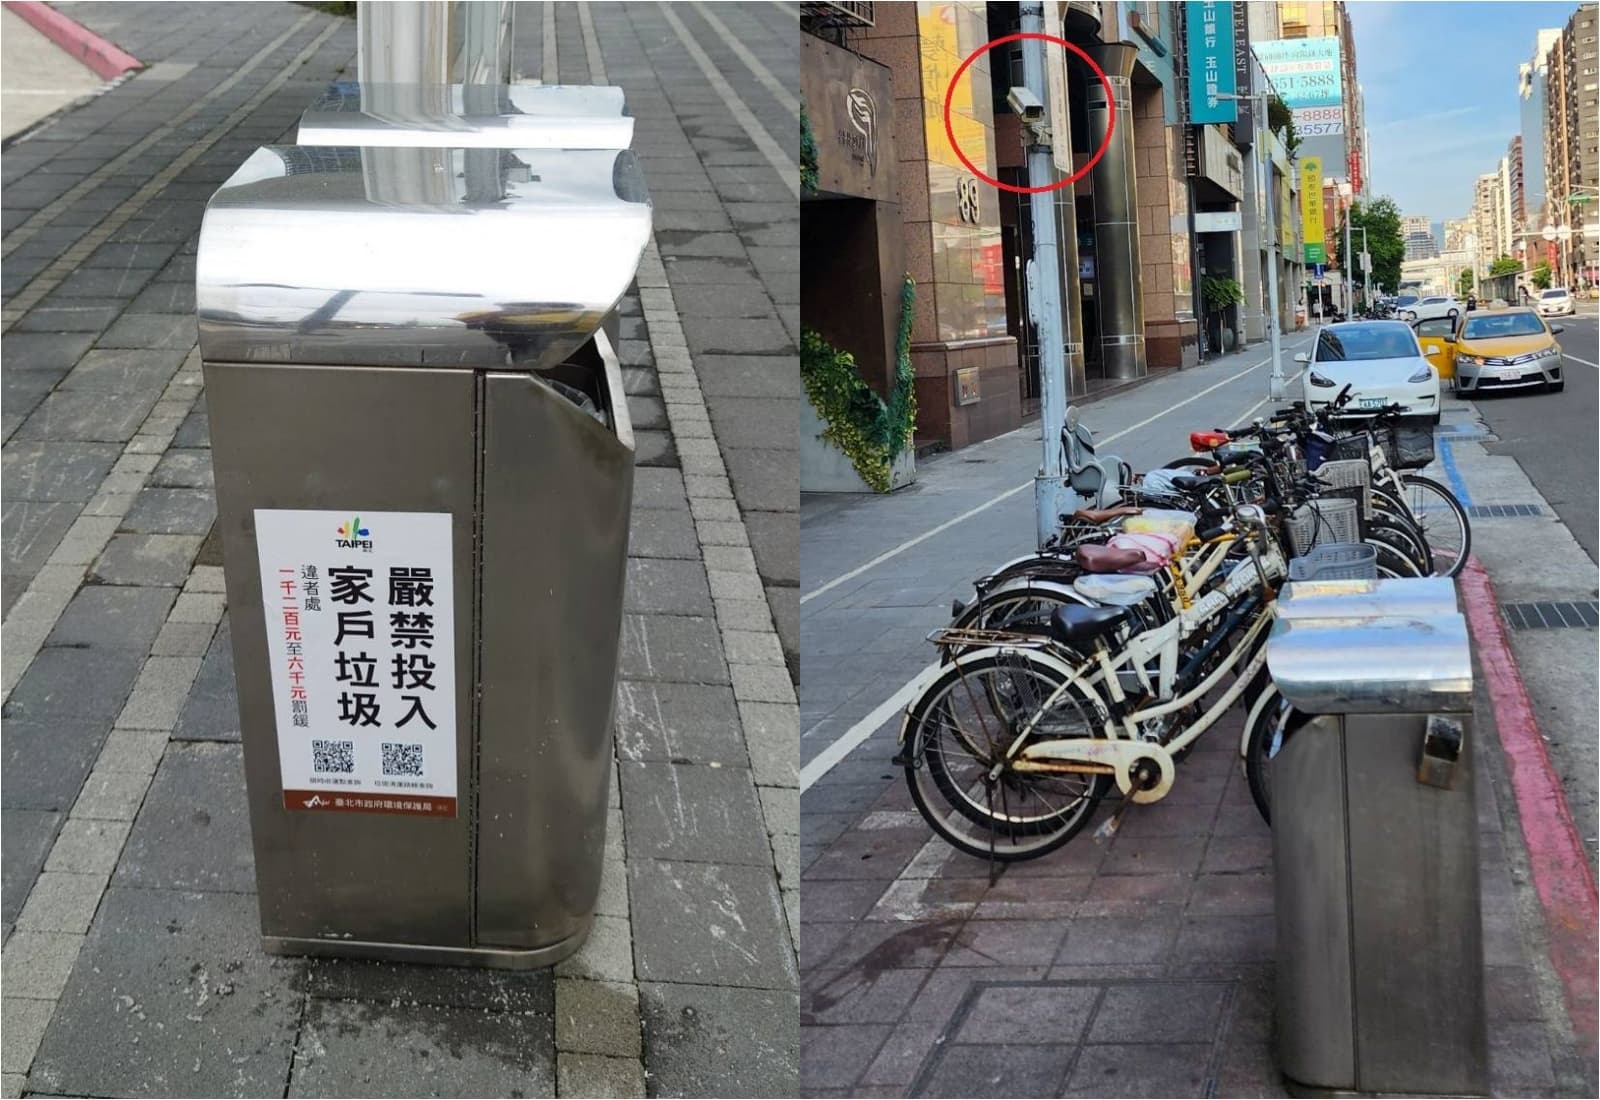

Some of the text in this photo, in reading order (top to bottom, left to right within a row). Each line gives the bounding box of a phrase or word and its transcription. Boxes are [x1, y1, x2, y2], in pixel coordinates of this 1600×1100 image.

[1236, 39, 1246, 74] EAST
[957, 176, 980, 224] 89
[335, 539, 373, 549] TAIPEI
[301, 564, 322, 612] 違者處
[328, 565, 381, 728] 家戶垃圾
[388, 566, 437, 730] 嚴禁投入
